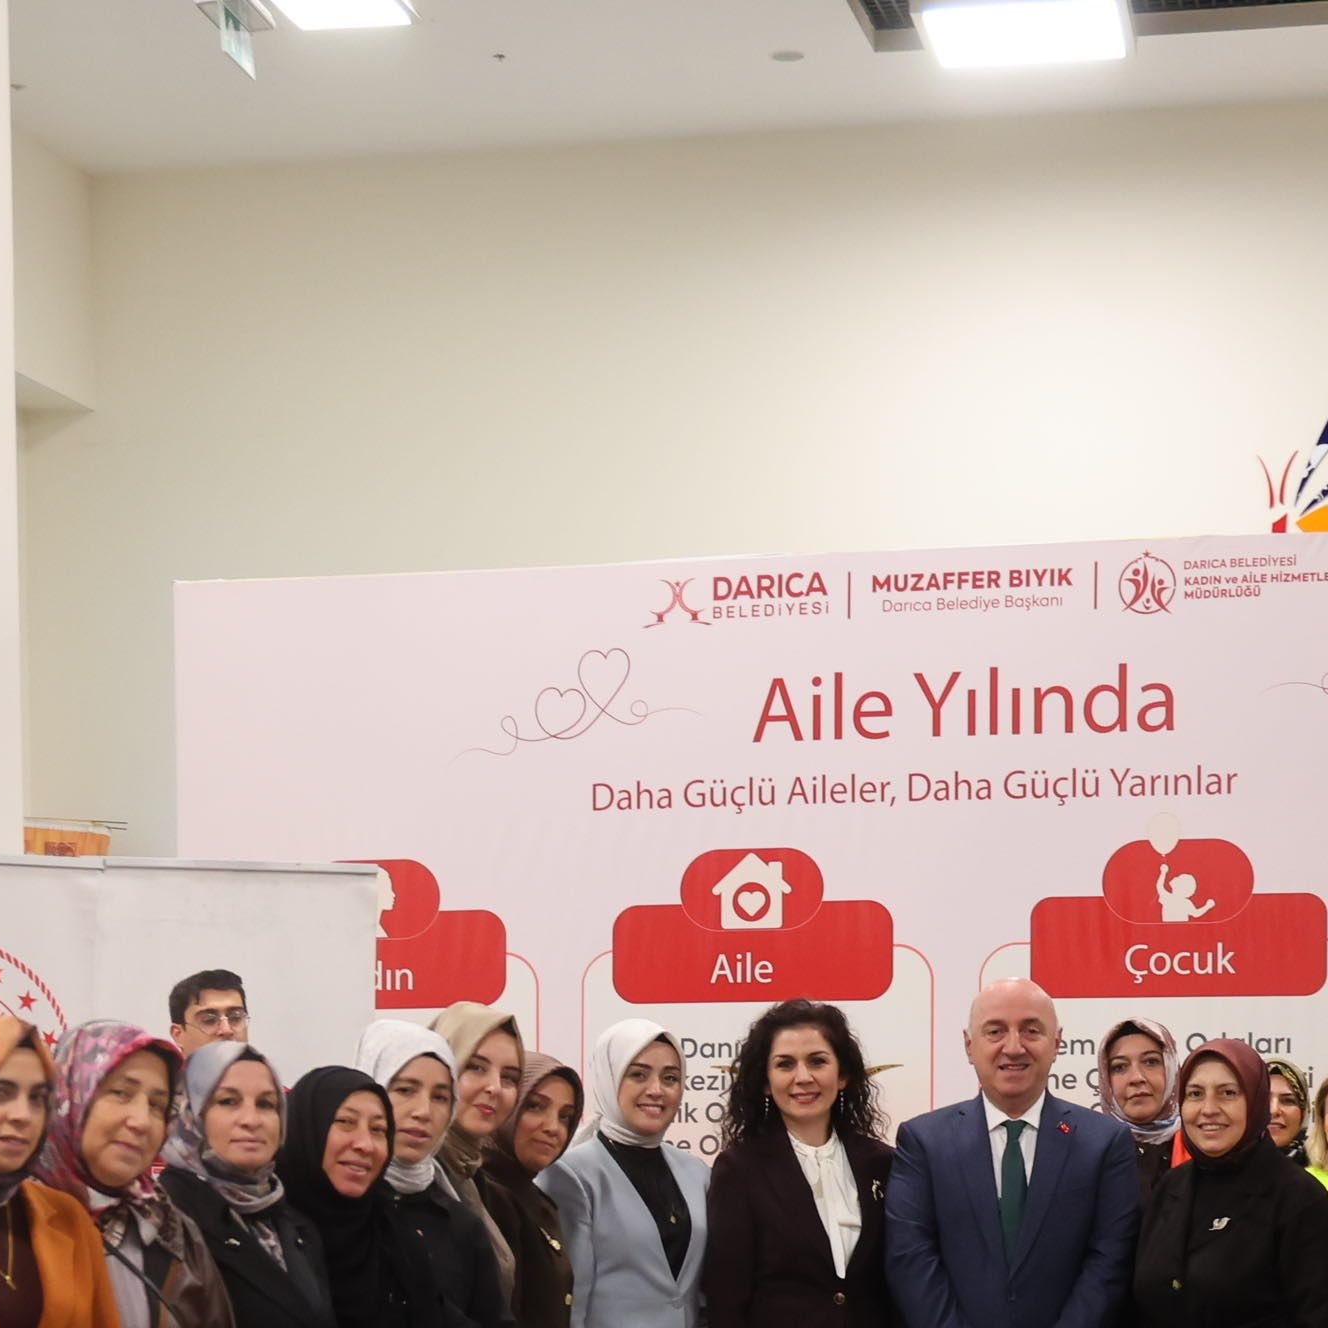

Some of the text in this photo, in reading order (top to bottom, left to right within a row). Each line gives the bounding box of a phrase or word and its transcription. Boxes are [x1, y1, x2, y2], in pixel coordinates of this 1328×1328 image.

[1183, 554, 1297, 570] DARICA BELEDİYESİ
[712, 571, 829, 601] DARICA
[871, 568, 1074, 593] MUZAFFER BIYIK
[1184, 575, 1222, 586] KADIN
[1224, 576, 1238, 584] ve
[1241, 571, 1268, 584] AİLE
[882, 594, 1064, 613] Darıca Belediye Başkanı
[1184, 585, 1261, 600] MÜDÜRLÜĞÜ
[752, 662, 1176, 743] Aile Yılında
[591, 765, 1238, 814] Daha Güçlü Aileler, Daha Güçlü Yarınlar
[710, 951, 774, 985] Aile
[1124, 942, 1236, 984] Çocuk
[1185, 1031, 1292, 1054] Oları
